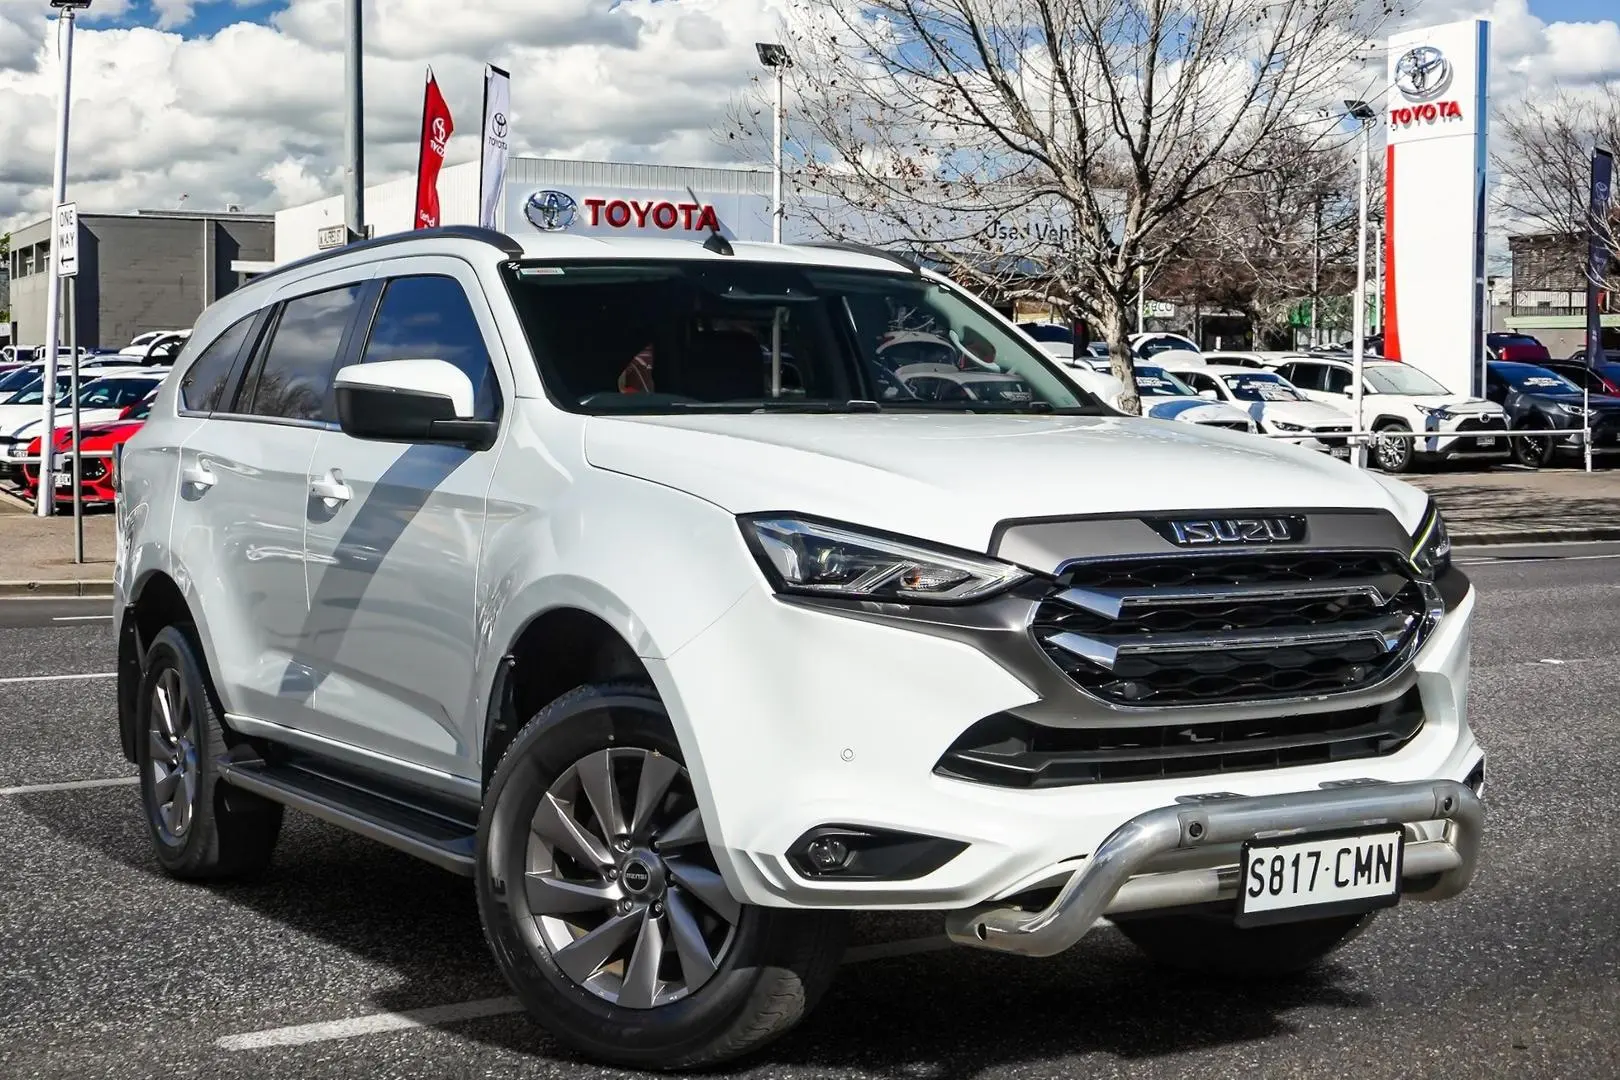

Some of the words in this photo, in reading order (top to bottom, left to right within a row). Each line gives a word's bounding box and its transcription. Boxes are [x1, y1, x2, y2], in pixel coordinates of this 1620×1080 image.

[1390, 101, 1462, 125] TOYOTA
[60, 210, 74, 227] ONE
[584, 199, 720, 231] TOYOTA
[60, 232, 75, 249] WAY
[1170, 519, 1291, 544] ISUZU
